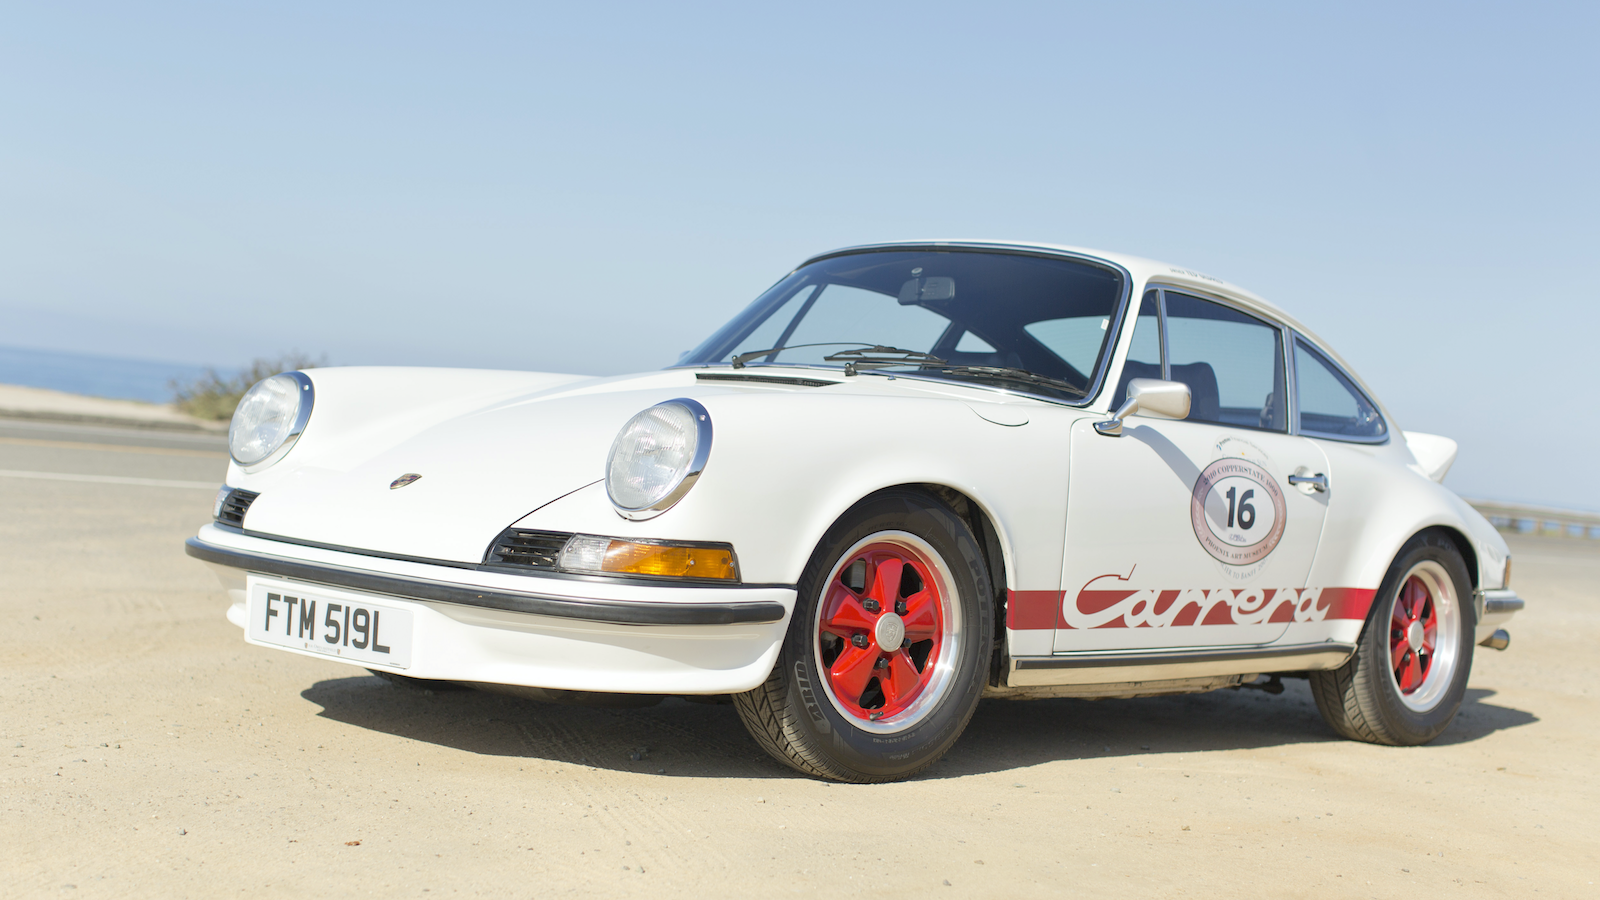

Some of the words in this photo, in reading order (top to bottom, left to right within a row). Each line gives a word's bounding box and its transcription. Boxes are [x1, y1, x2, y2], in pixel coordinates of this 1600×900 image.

[1203, 469, 1217, 486] 2010
[1217, 464, 1265, 483] COPPERSTATE
[1226, 486, 1256, 530] 16
[1205, 536, 1230, 558] PHOENIX
[1243, 543, 1269, 559] MUSEUM
[1063, 563, 1331, 629] Carrera
[1232, 571, 1241, 580] TO
[1240, 568, 1257, 580] BANFF
[265, 592, 316, 640] FTM
[324, 603, 391, 654] 519L
[966, 559, 989, 694] POTENZA
